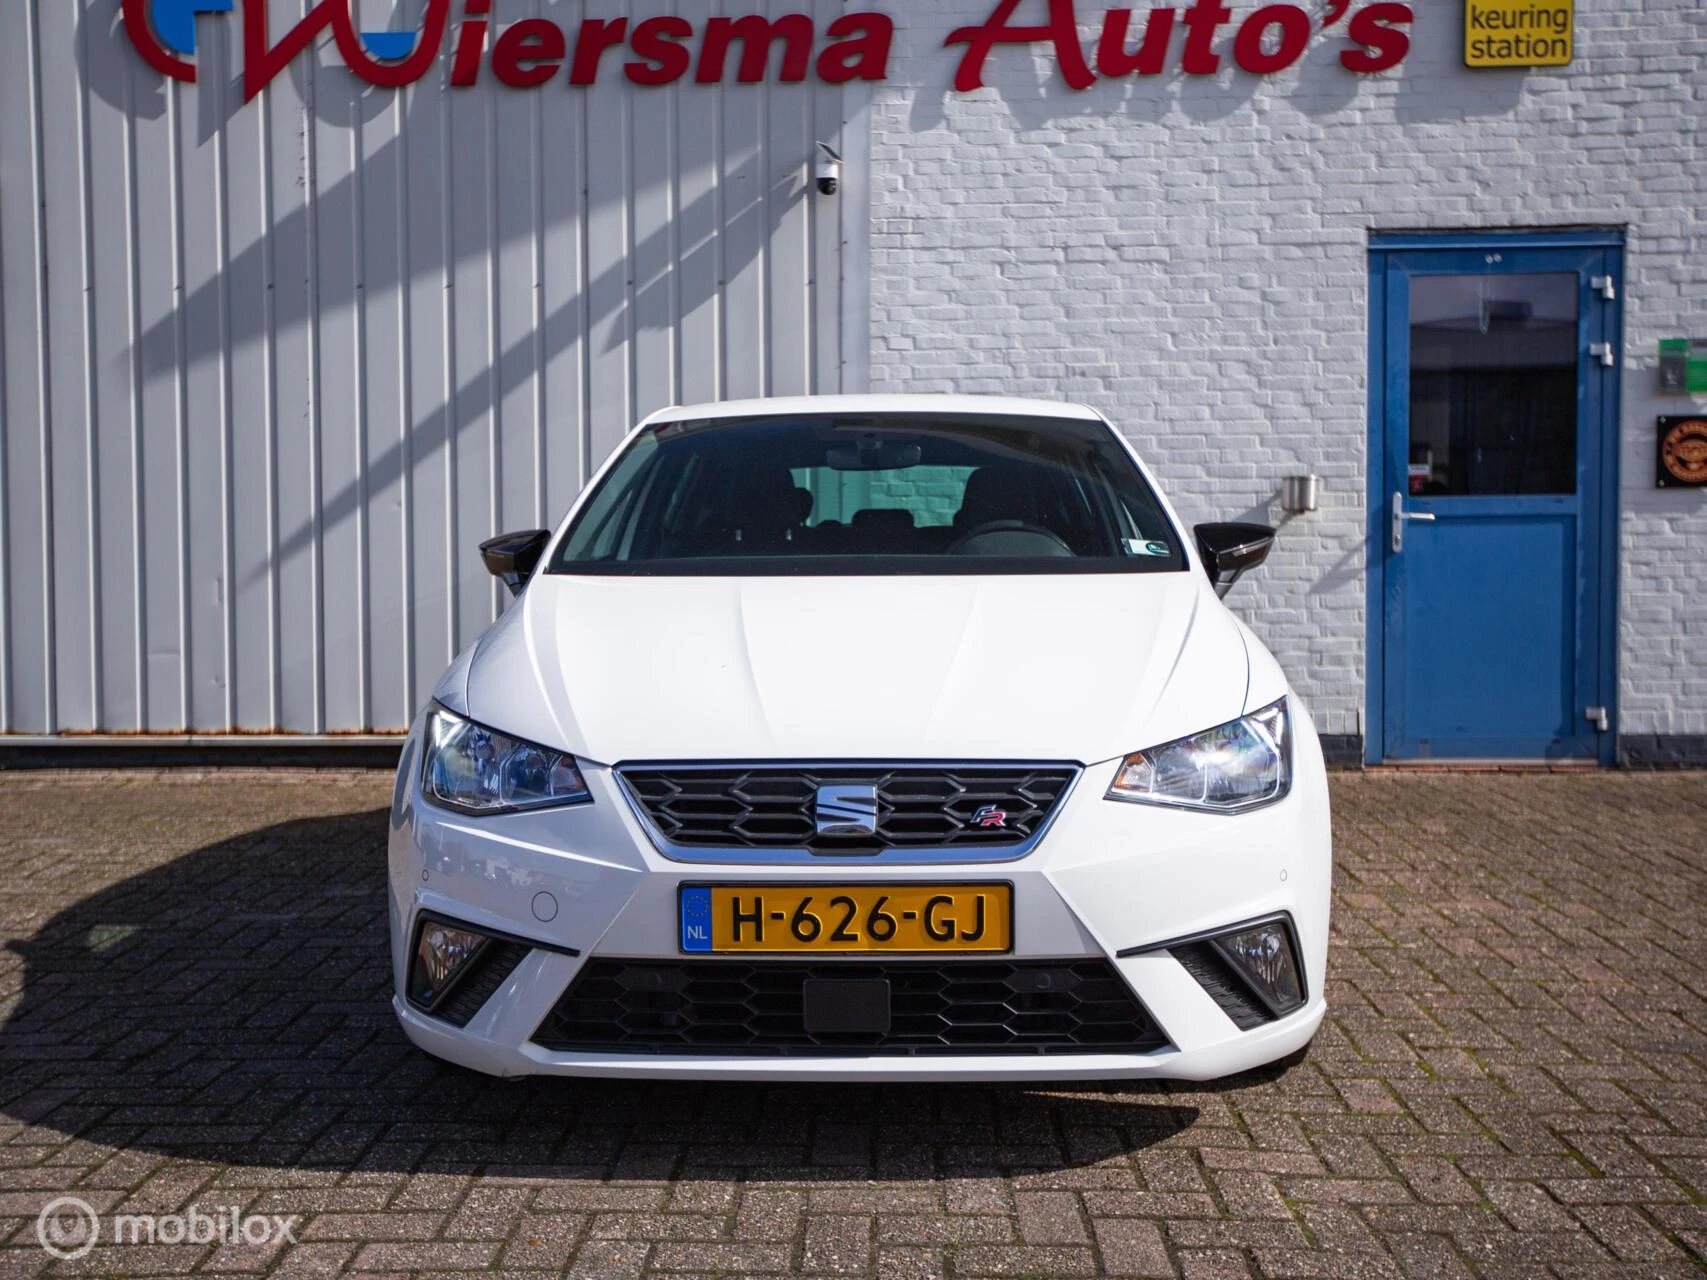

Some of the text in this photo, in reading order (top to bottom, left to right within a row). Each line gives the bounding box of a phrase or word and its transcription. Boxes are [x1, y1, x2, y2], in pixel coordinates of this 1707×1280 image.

[1471, 4, 1568, 34] keuring
[943, 0, 1414, 92] Auto's
[1470, 34, 1567, 59] station
[687, 894, 987, 943] NL H-626-GJ
